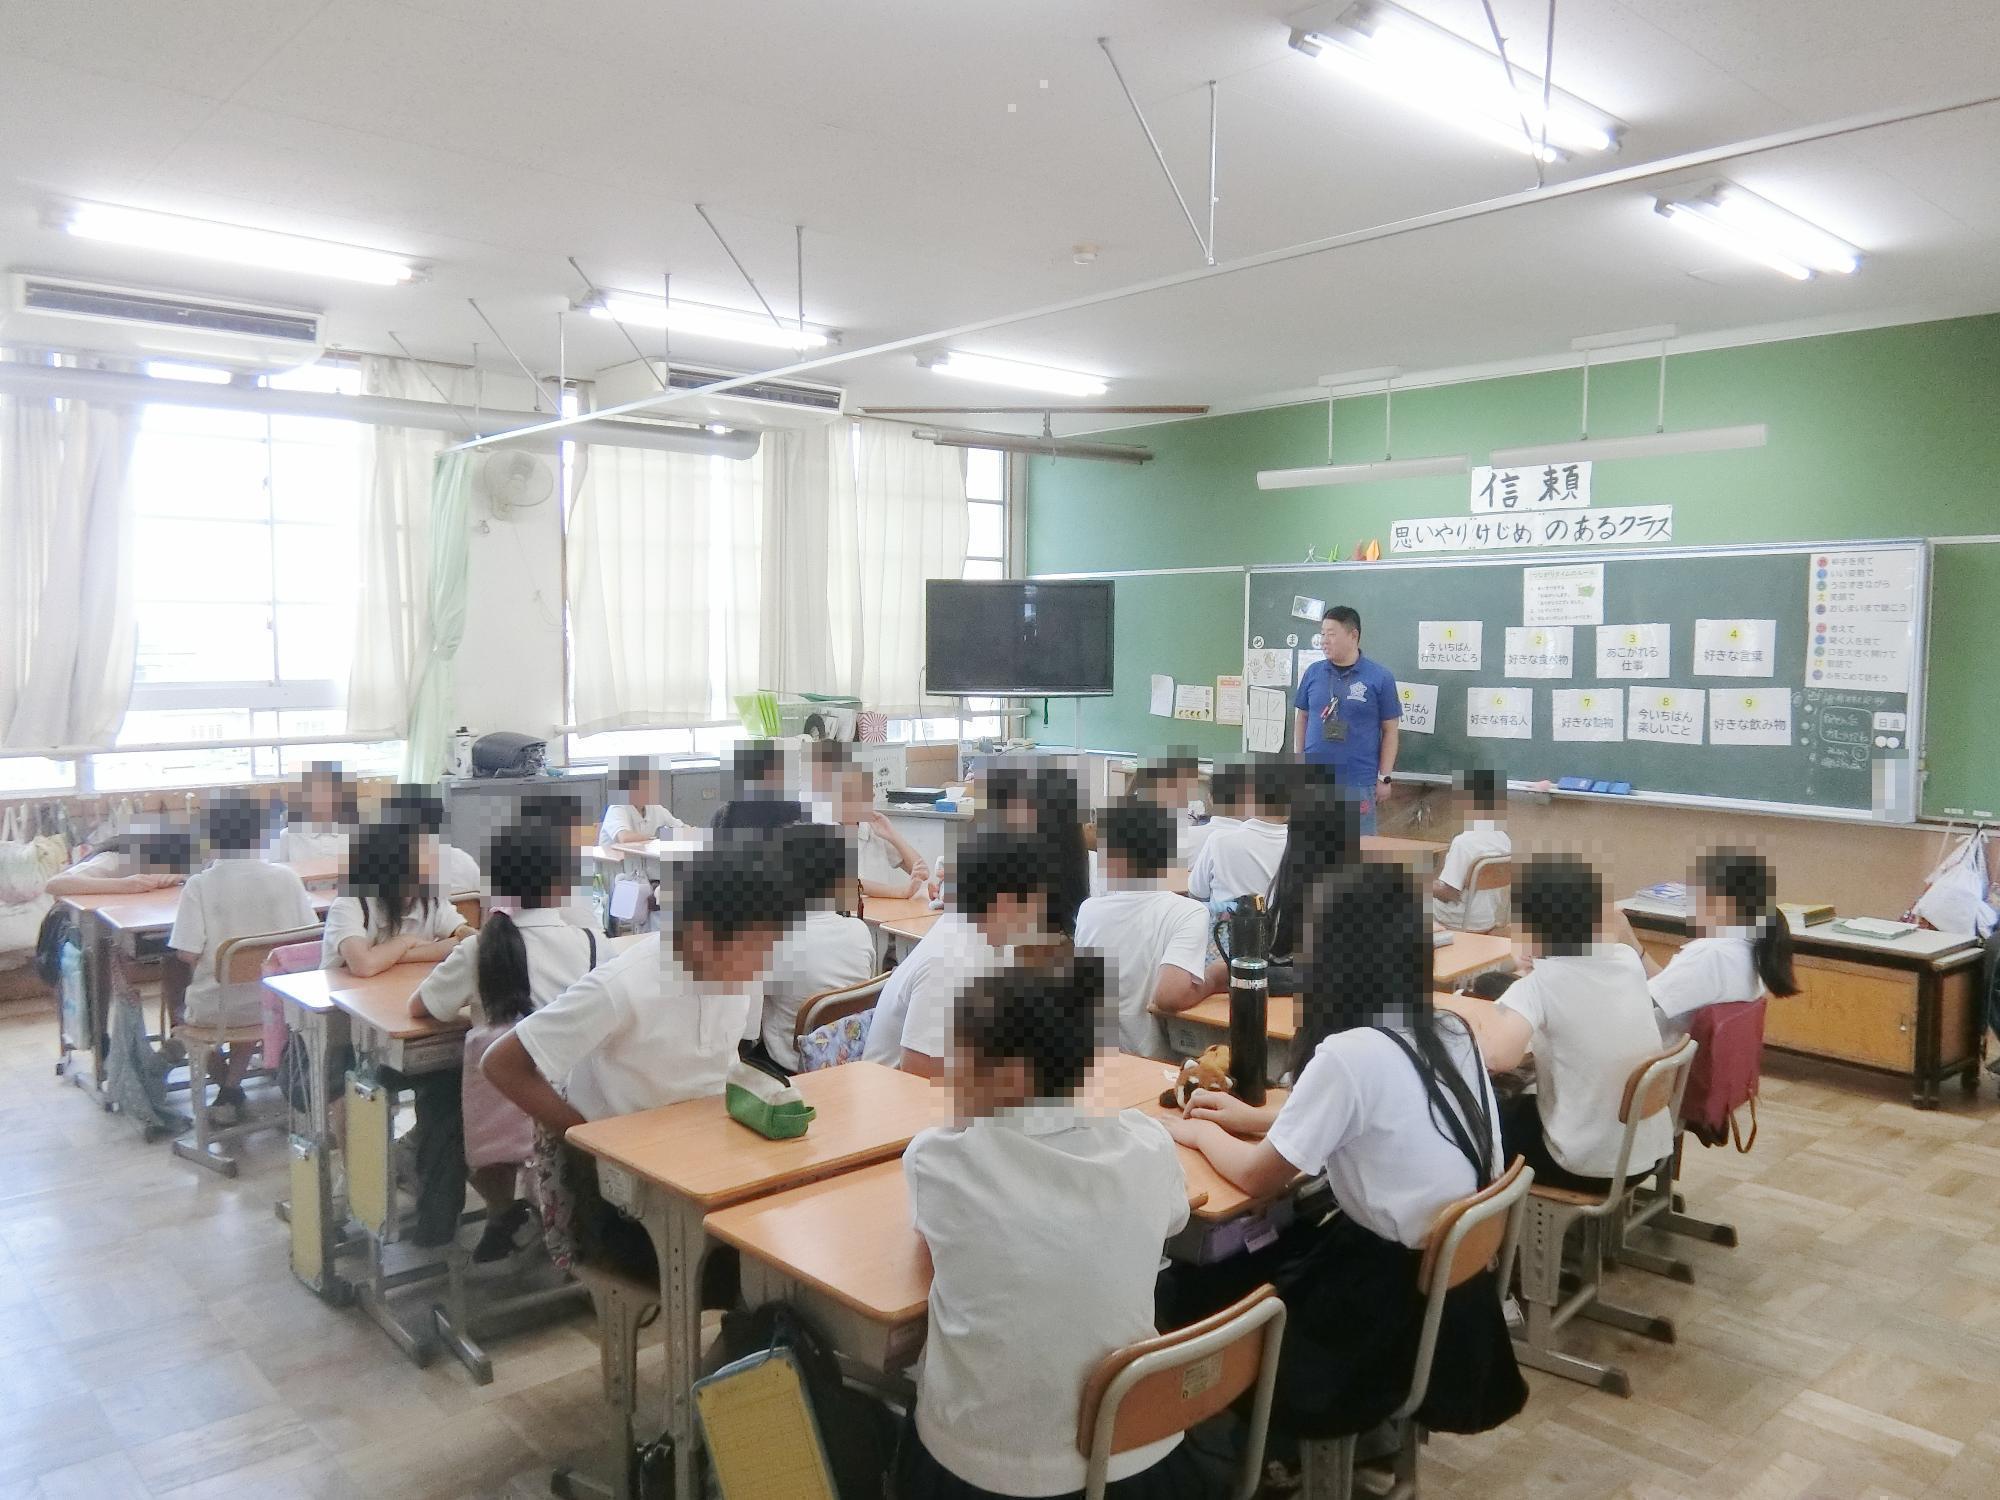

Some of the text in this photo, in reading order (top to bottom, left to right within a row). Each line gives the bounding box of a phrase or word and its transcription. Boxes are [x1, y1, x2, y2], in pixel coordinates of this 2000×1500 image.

[1427, 642, 1471, 652] 今いちばん
[1606, 647, 1659, 658] あこがれる
[1421, 653, 1478, 663] 行きたいところ
[1508, 654, 1568, 665] 好きな食べ物
[1704, 650, 1764, 662] 好きな言葉
[1622, 660, 1643, 671] 仕事
[1404, 690, 1410, 699] 5
[1745, 698, 1753, 707] 9
[1470, 713, 1528, 726] 好きな有名人
[1639, 709, 1693, 722] 今いちばん
[1713, 718, 1786, 730] 好きな飲み物
